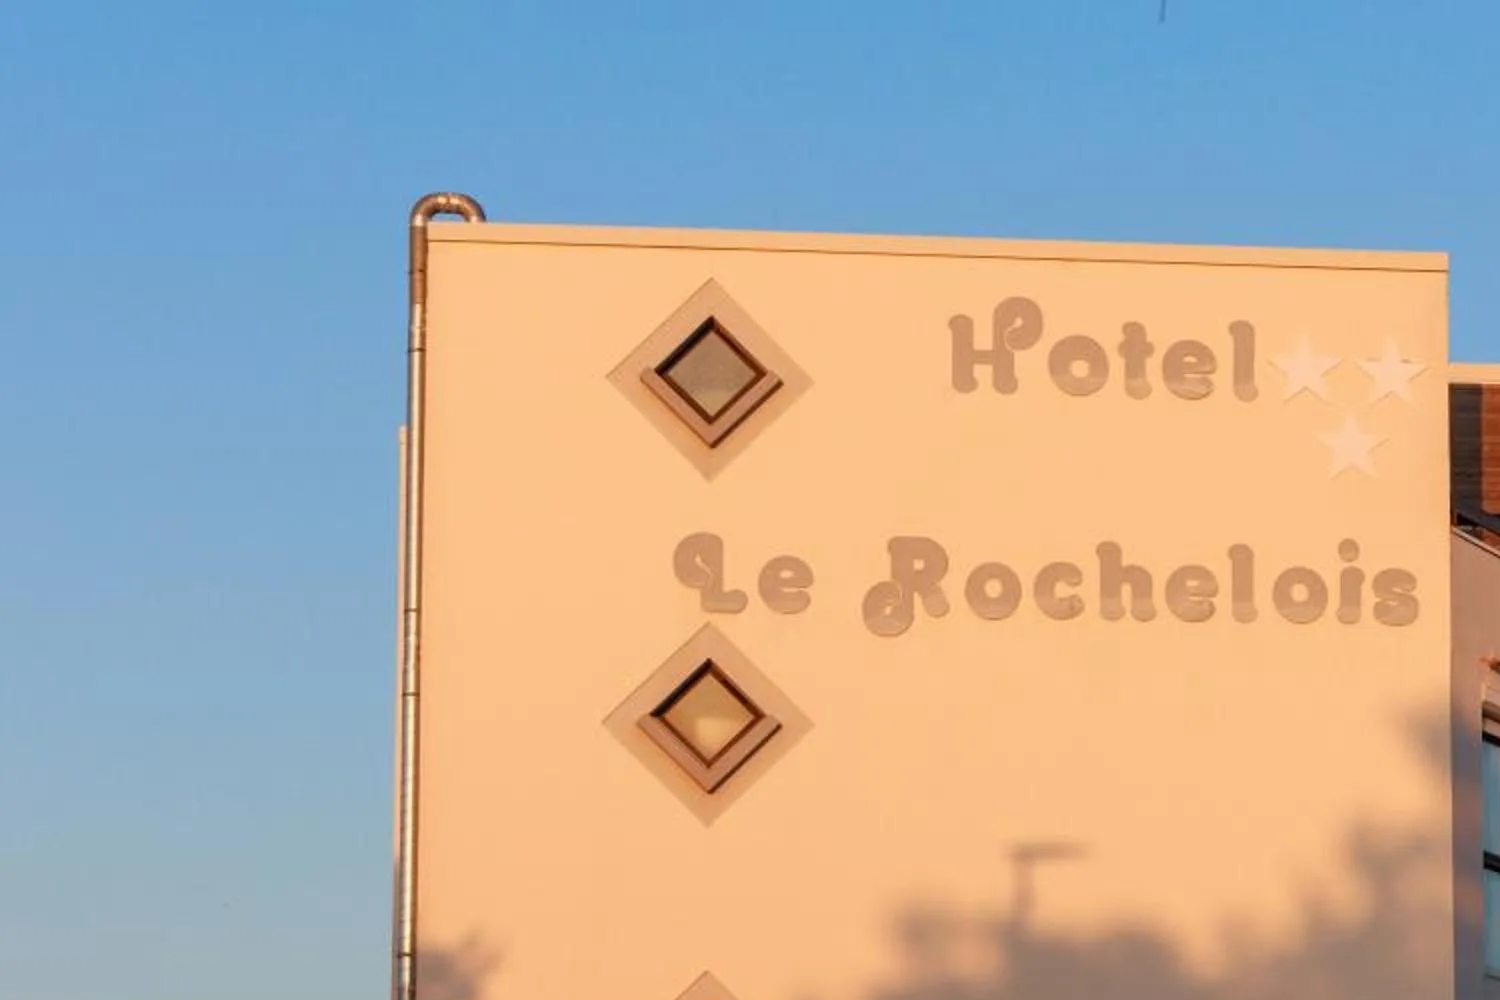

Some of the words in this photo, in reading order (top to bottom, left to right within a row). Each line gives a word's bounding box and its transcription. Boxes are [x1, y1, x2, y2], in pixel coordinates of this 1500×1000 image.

[948, 297, 1257, 401] Hotel
[673, 532, 814, 614] Le
[862, 535, 1419, 637] Rochelois
